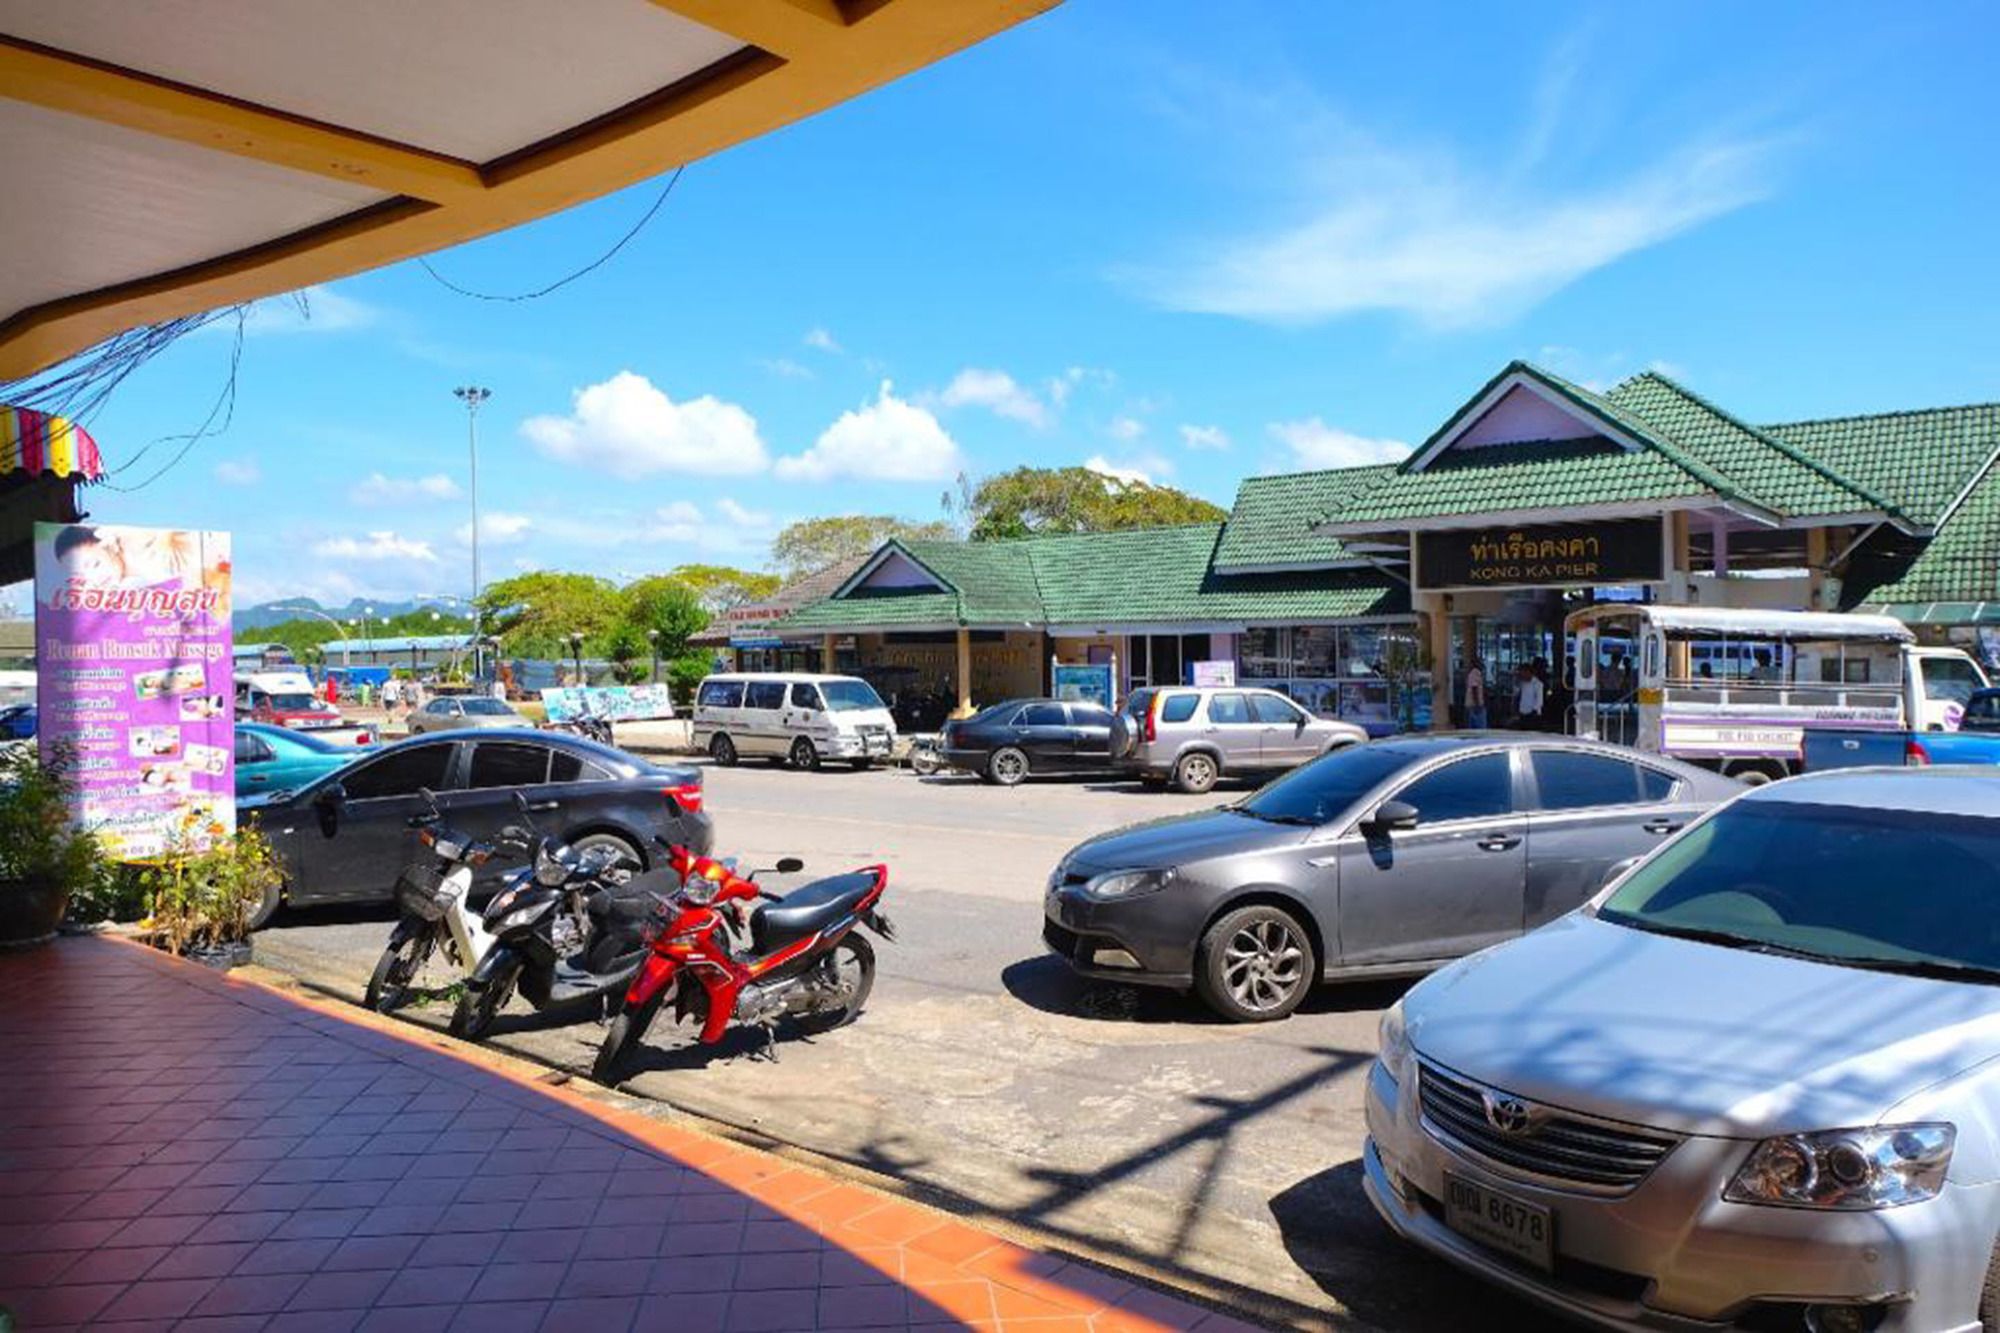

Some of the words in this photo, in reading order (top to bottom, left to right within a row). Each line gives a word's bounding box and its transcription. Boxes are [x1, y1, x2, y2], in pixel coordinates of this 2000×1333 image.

[1470, 532, 1599, 560] ท่าเรือคงคา
[1470, 566, 1520, 579] KONG
[1526, 564, 1551, 577] KA
[1556, 562, 1598, 576] PIER
